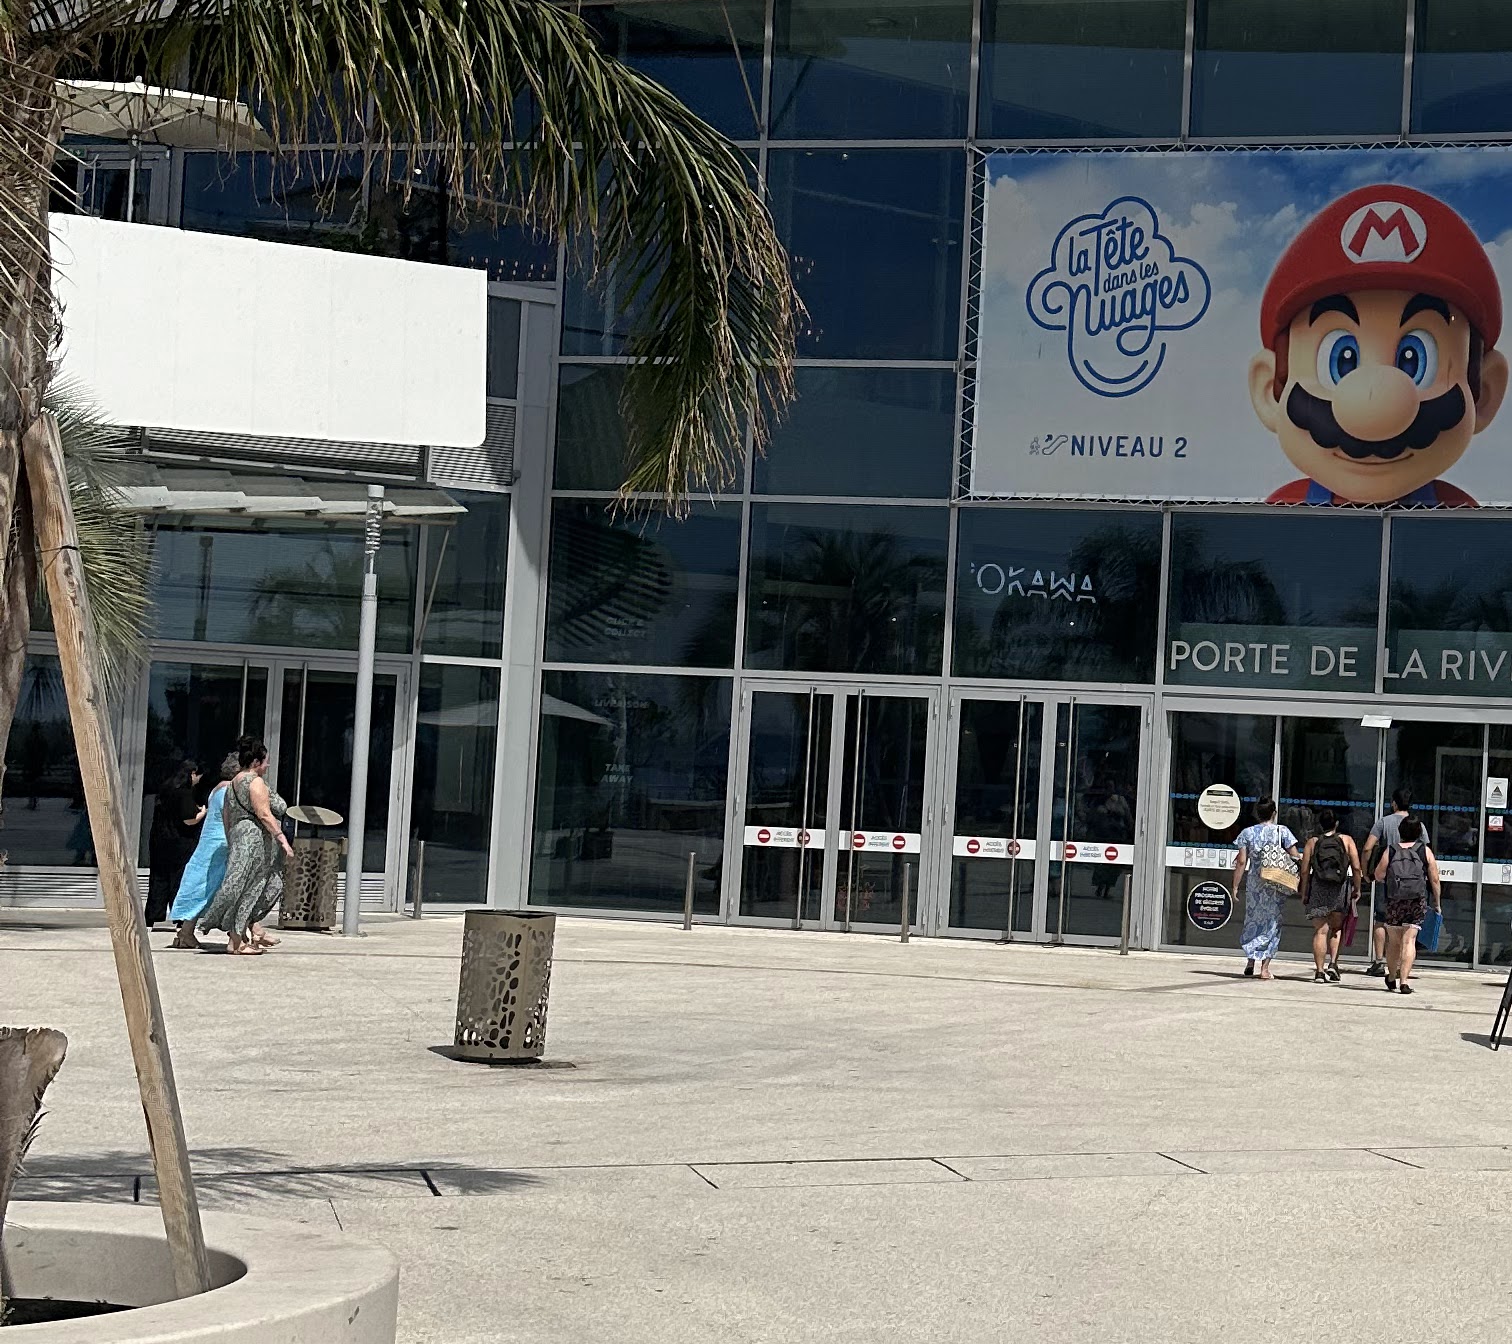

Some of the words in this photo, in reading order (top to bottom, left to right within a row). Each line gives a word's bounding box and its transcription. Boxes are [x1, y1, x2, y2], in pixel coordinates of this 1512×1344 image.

[1348, 208, 1420, 257] M
[1079, 216, 1150, 297] Tête
[1103, 272, 1138, 294] dans
[1139, 260, 1160, 281] les
[1042, 269, 1190, 340] Nuages
[1071, 435, 1164, 457] NIVEAU
[1174, 436, 1188, 458] 2
[1170, 640, 1290, 674] PORTE
[1310, 645, 1359, 677] DE
[1383, 647, 1428, 680] LA
[601, 774, 633, 783] AWAY
